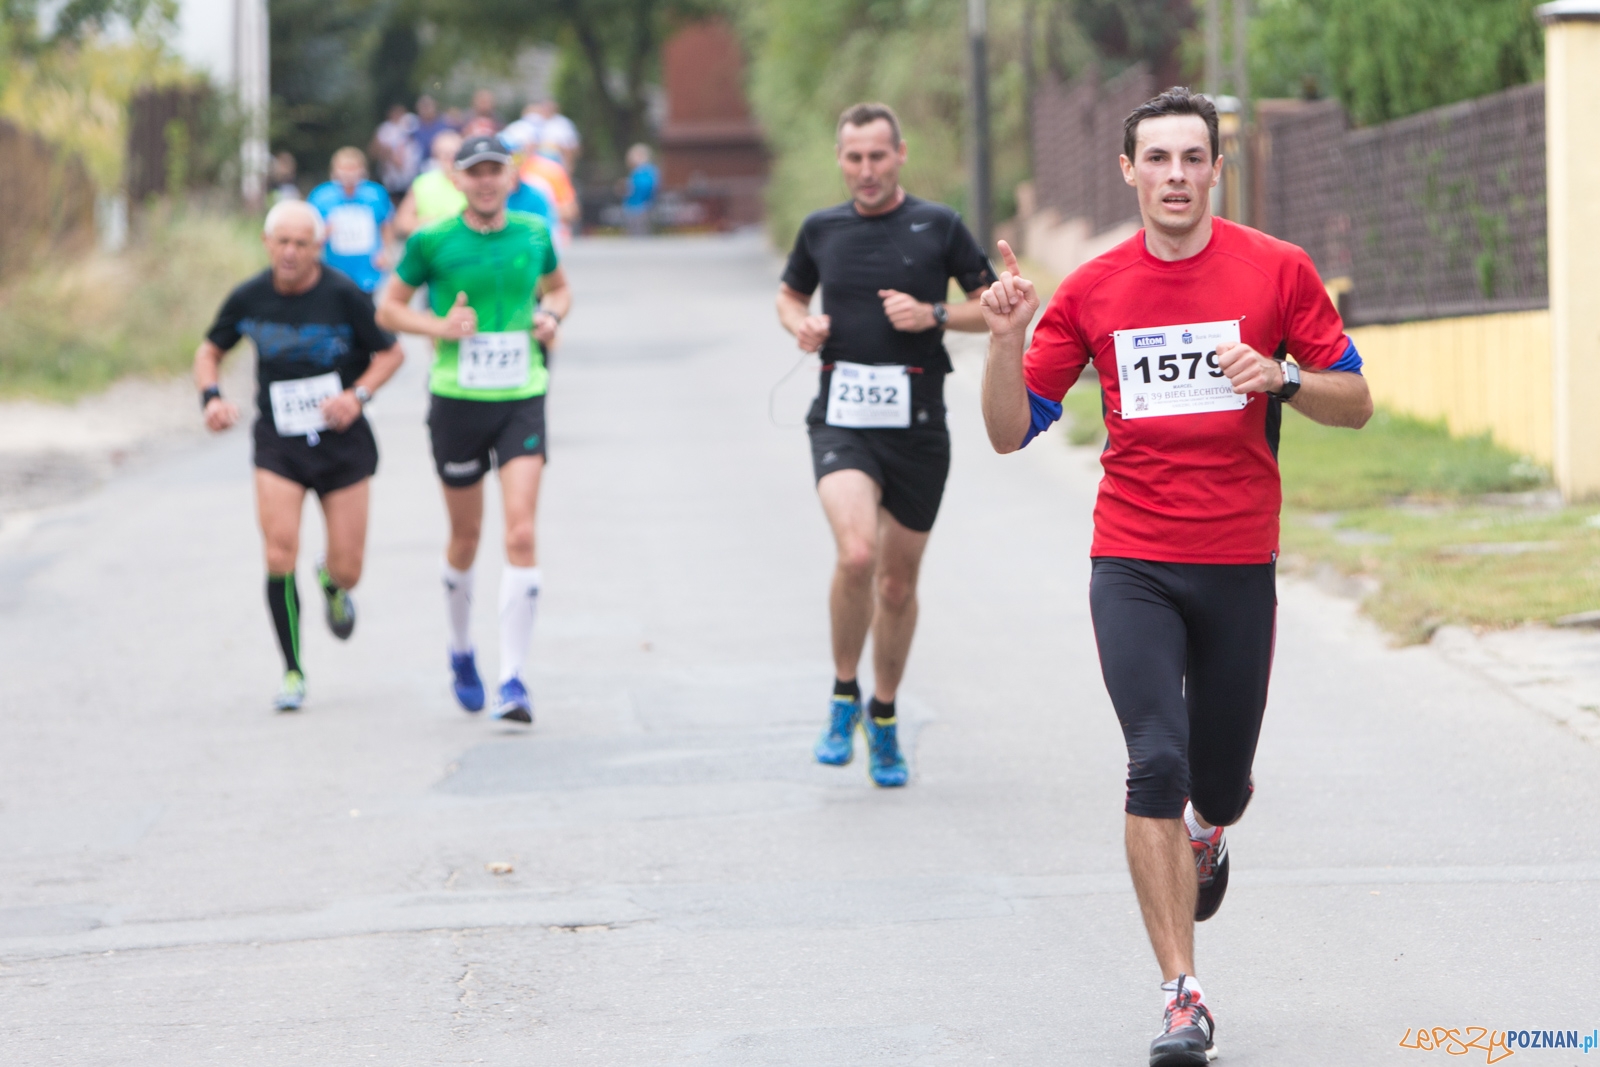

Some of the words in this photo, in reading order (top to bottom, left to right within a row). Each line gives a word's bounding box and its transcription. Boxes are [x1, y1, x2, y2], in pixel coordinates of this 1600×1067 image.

[839, 383, 898, 404] 2352
[1151, 392, 1162, 400] 39
[1165, 390, 1186, 399] BIEG
[1188, 385, 1233, 397] LECHITÓW
